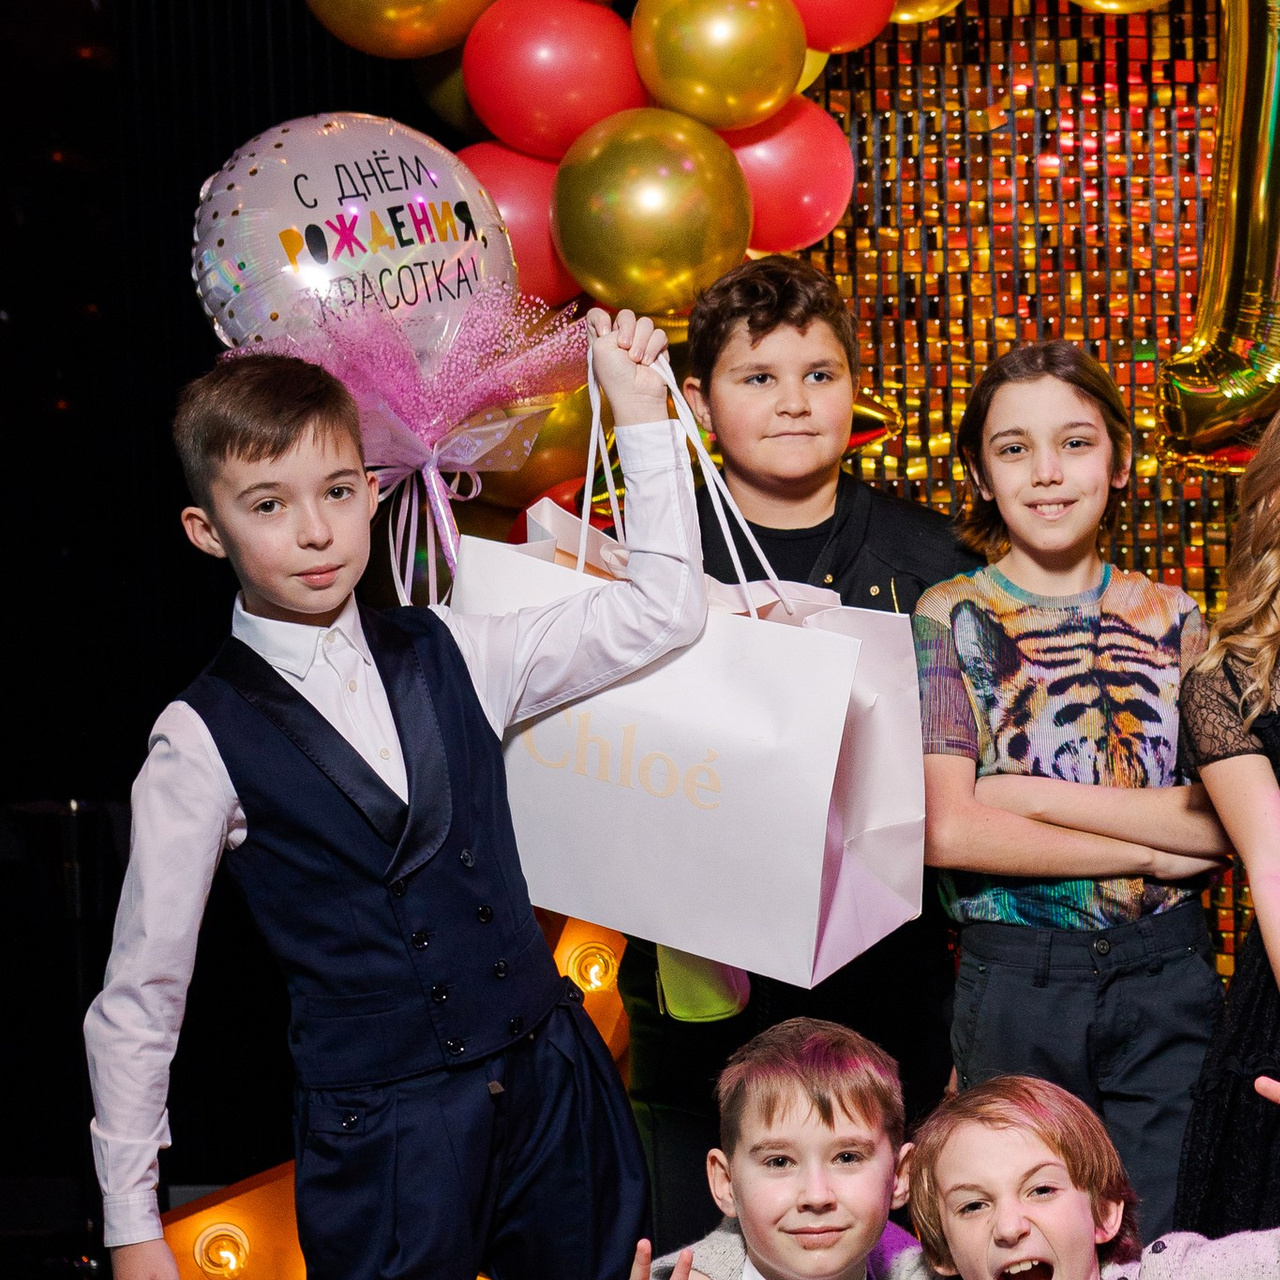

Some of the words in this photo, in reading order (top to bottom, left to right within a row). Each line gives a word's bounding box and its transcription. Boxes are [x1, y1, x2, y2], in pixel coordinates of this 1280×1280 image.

[294, 173, 319, 209] С
[334, 149, 438, 206] ДНЁМ
[518, 707, 723, 810] Chloé
